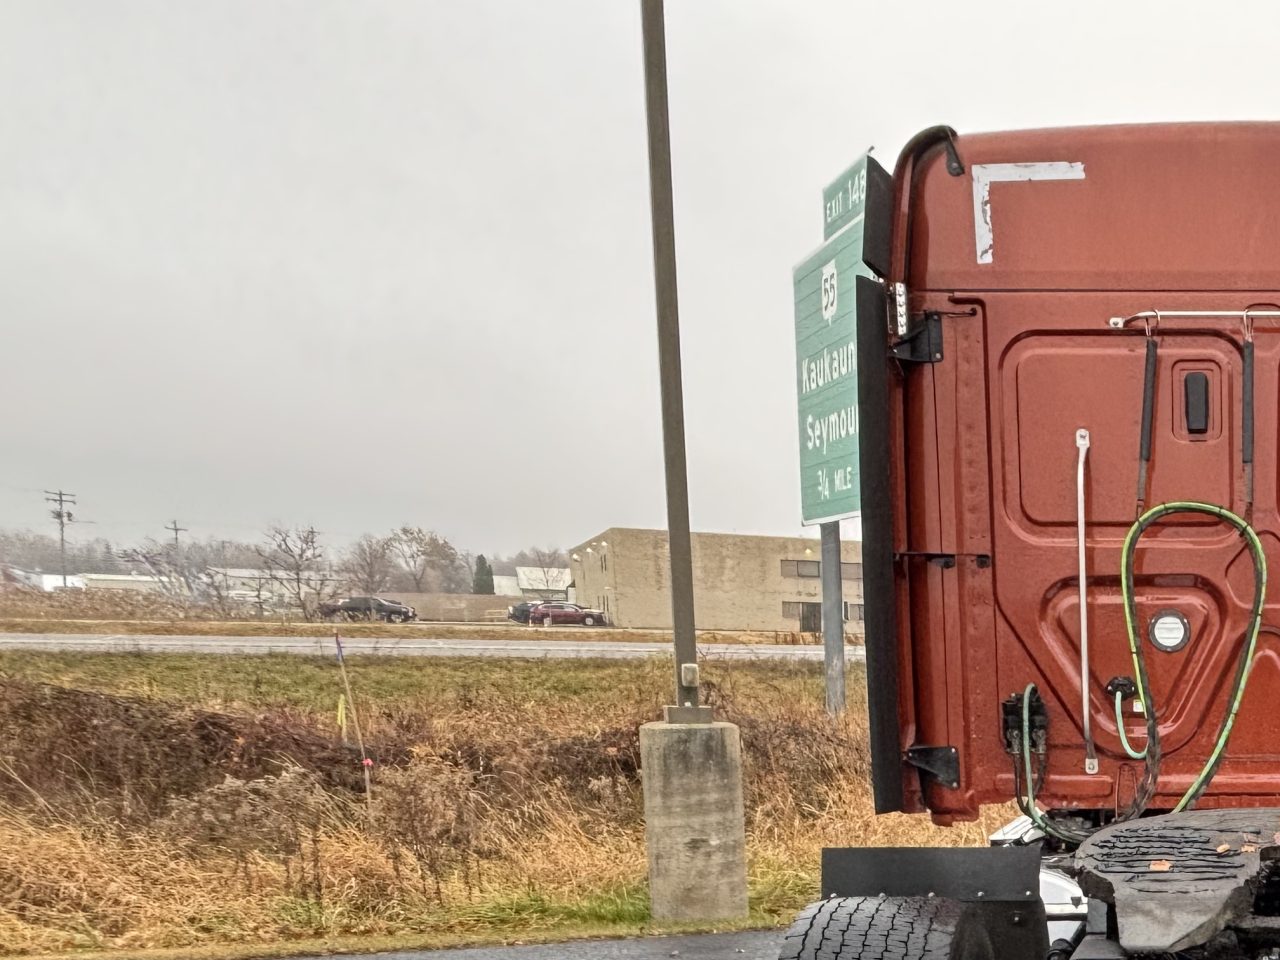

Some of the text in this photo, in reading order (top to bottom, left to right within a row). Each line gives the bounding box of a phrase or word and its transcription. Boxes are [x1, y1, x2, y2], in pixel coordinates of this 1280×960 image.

[826, 168, 866, 223] EXIT 148
[823, 272, 836, 312] 55
[802, 341, 857, 394] Kaukaun
[834, 466, 852, 493] MILE
